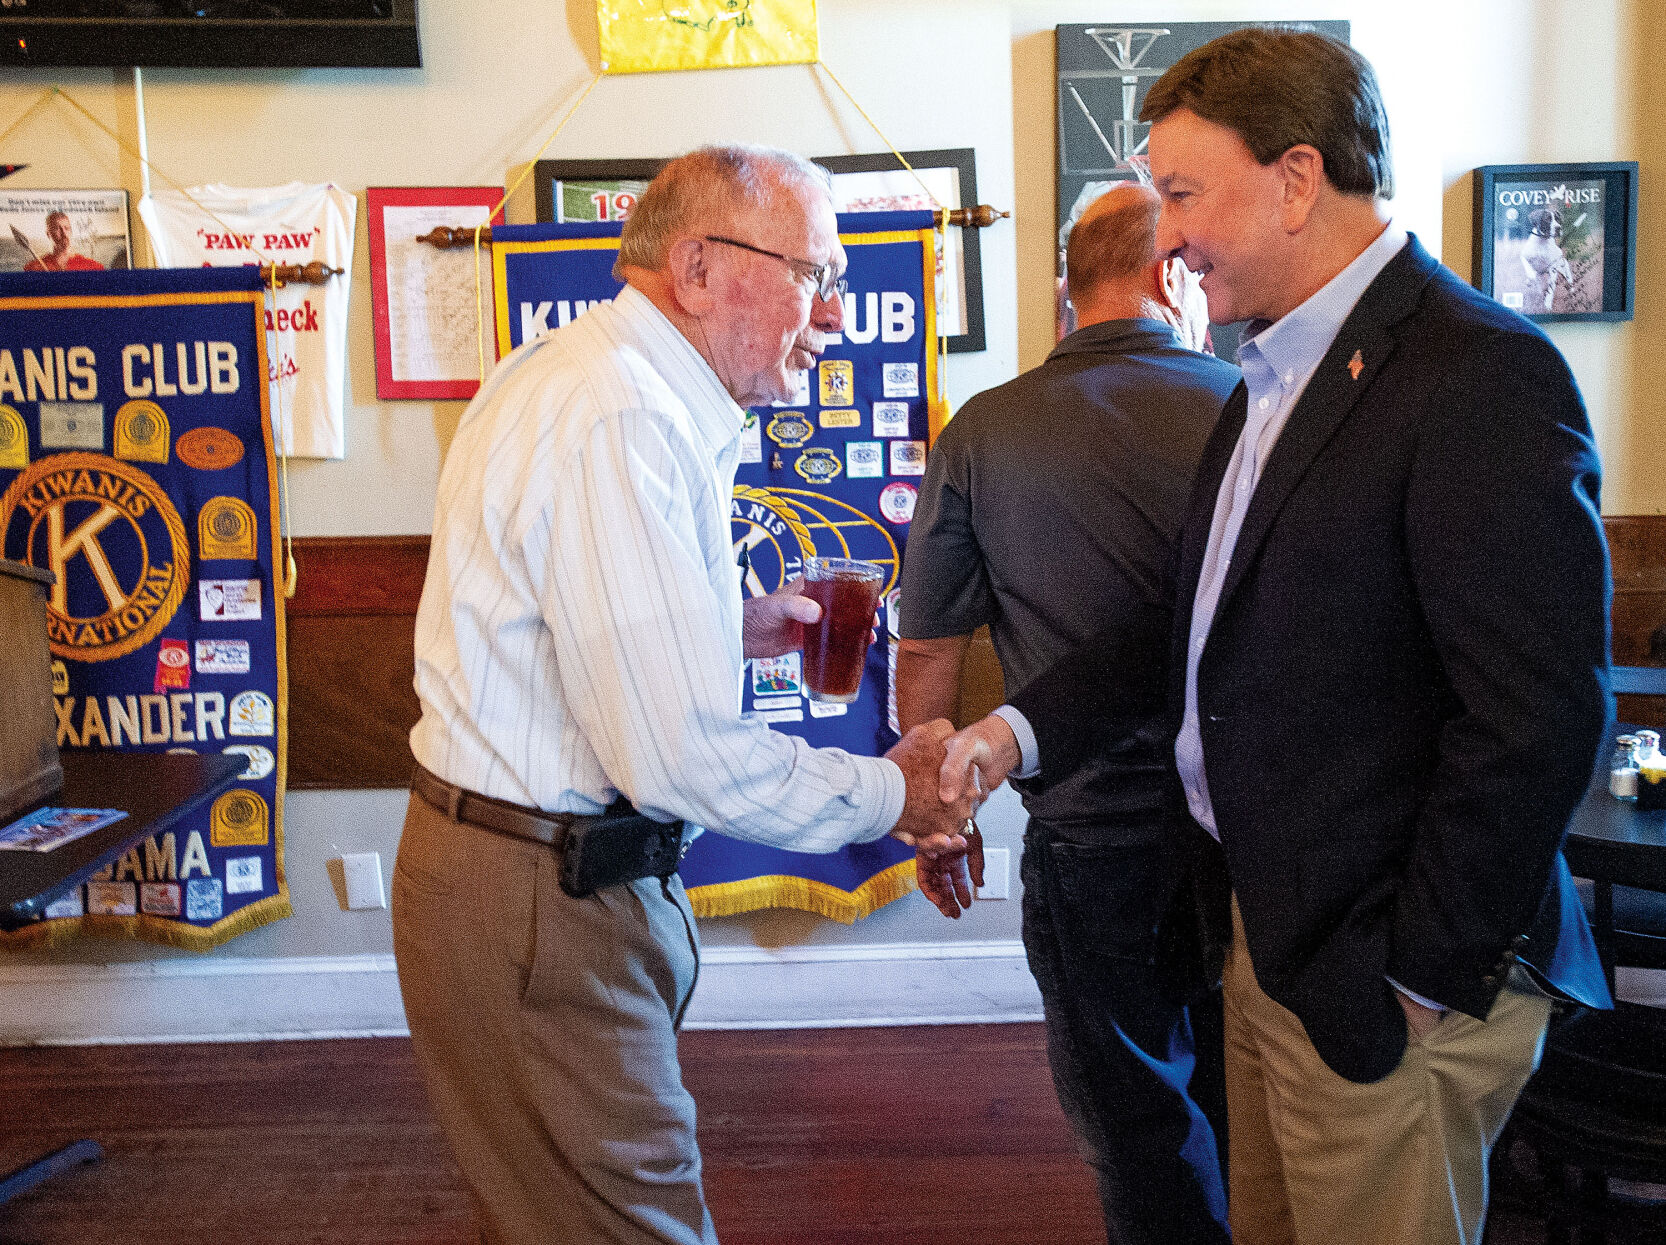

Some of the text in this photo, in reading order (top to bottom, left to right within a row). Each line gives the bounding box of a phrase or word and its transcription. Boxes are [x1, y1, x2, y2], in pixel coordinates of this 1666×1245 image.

[1500, 188, 1600, 206] COVEY RISE
[121, 340, 240, 398] CLUB
[20, 469, 150, 518] KIWANIS
[48, 501, 127, 616] K
[53, 690, 226, 747] XANDER
